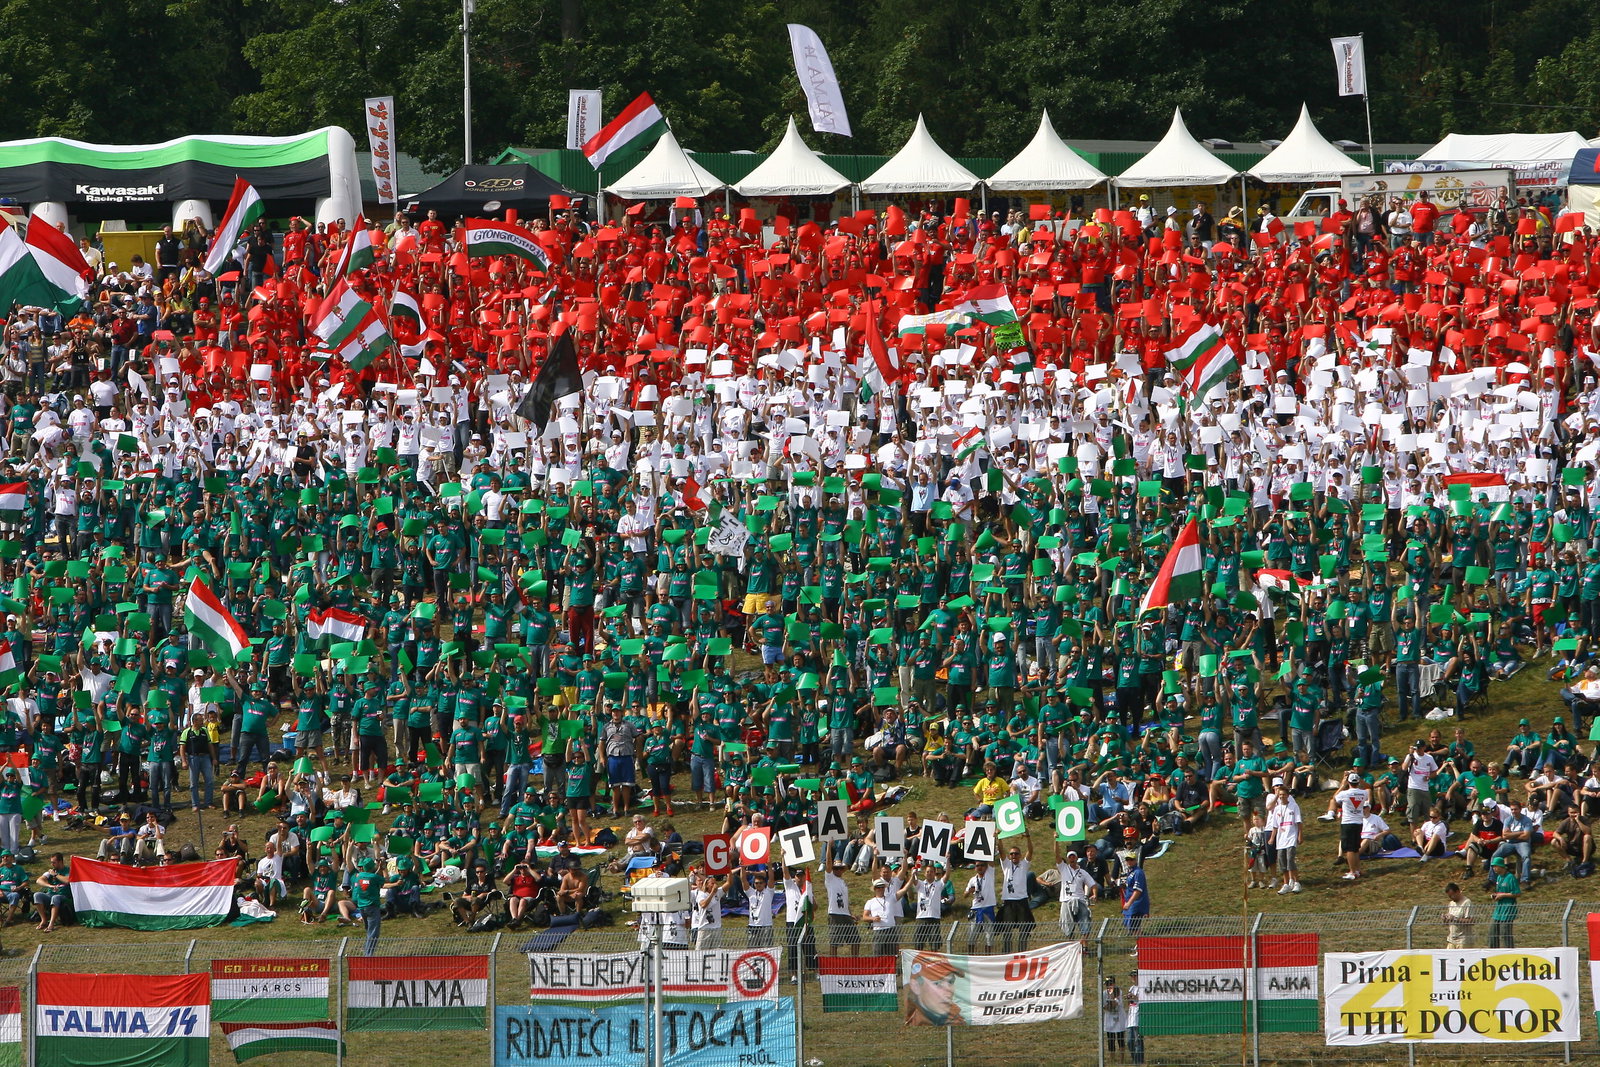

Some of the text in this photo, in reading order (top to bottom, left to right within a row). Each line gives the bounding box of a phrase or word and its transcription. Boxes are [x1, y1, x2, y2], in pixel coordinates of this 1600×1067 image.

[75, 183, 164, 196] Kawasaki
[250, 963, 295, 973] Talma
[1340, 960, 1411, 985] Pirna
[1438, 956, 1561, 982] Liebethal
[837, 978, 885, 989] SZENTES
[1144, 976, 1311, 994] JÁNOSHÁZA AJKA
[373, 980, 465, 1008] TALMA
[977, 985, 1075, 1001] du fehlst uns!
[1429, 990, 1473, 1003] grüßt
[982, 1003, 1064, 1016] Deine Fans.
[45, 1006, 198, 1036] TALMA 14
[1340, 1008, 1564, 1036] THE DOCTOR
[506, 1016, 612, 1060] RIDATECI
[662, 1007, 763, 1057] TOCAI
